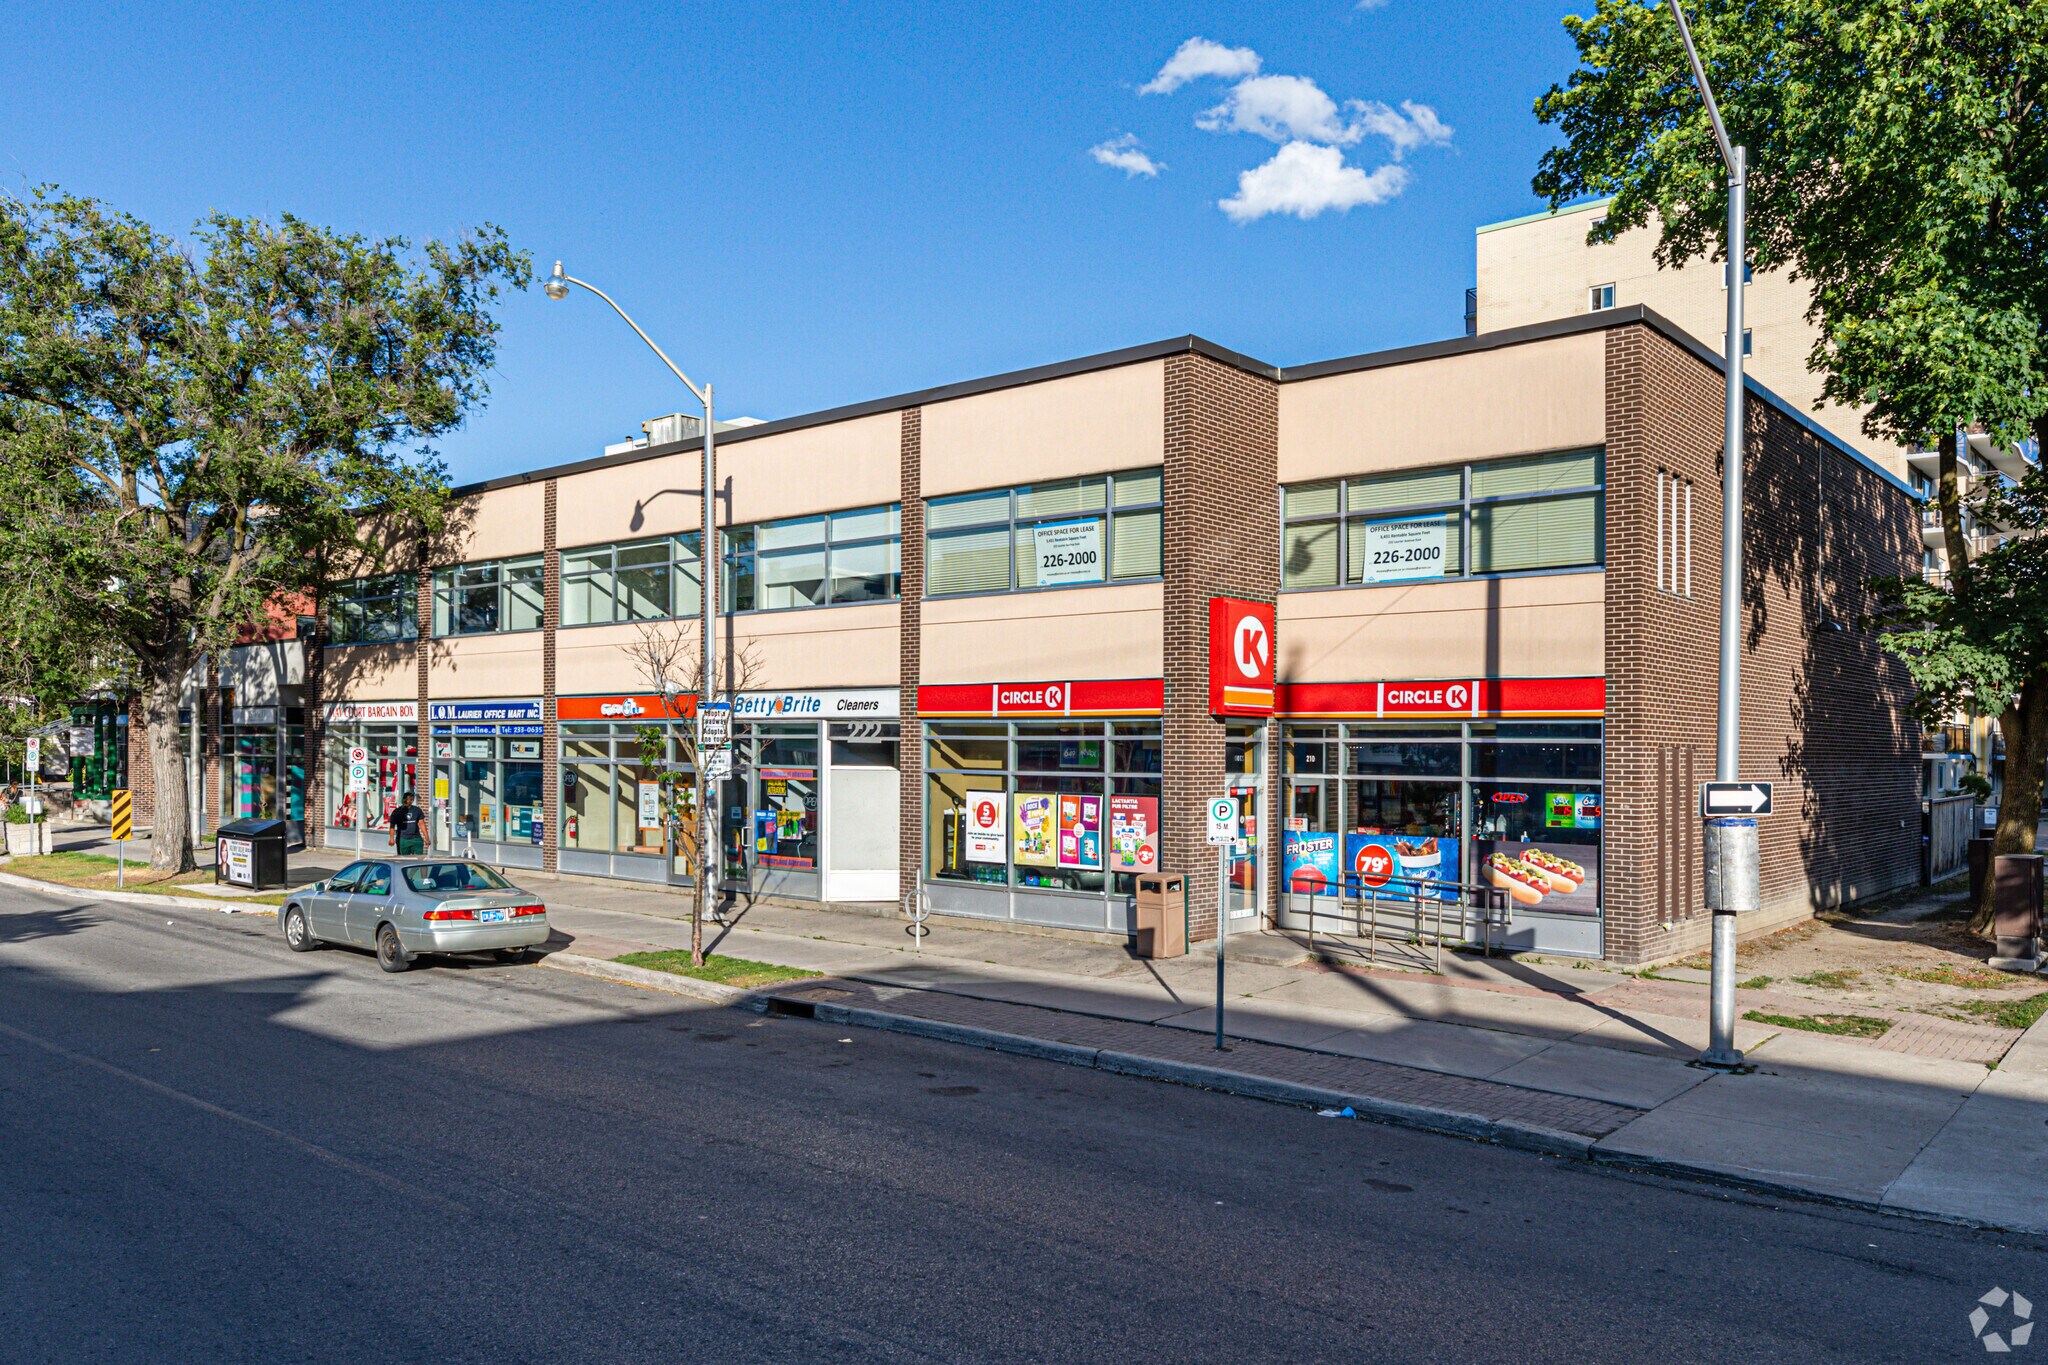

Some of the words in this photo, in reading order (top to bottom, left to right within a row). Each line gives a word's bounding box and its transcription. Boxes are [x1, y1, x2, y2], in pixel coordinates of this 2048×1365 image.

[1370, 525, 1389, 533] OFFICE
[1391, 523, 1408, 531] SPACE
[1043, 551, 1097, 568] 226-2000
[1374, 547, 1440, 565] 226-2000
[1000, 690, 1043, 705] CIRCLE
[1387, 689, 1443, 704] CIRCLE
[343, 706, 366, 718] COURT
[367, 705, 398, 718] BARGAIN
[400, 705, 414, 717] BOX
[733, 696, 776, 716] Betty
[782, 695, 821, 713] Brite
[836, 699, 879, 711] Cleaners
[457, 710, 482, 719] LAURIER
[484, 709, 506, 719] OFFICE
[508, 709, 525, 719] MART
[501, 726, 512, 734] Tel:
[514, 726, 543, 734] 233-0635
[847, 721, 882, 743] 222
[1305, 755, 1316, 763] 210
[1492, 791, 1529, 804] OPEN
[982, 804, 991, 817] 5
[1218, 805, 1228, 817] P
[1285, 837, 1335, 856] FROSTER
